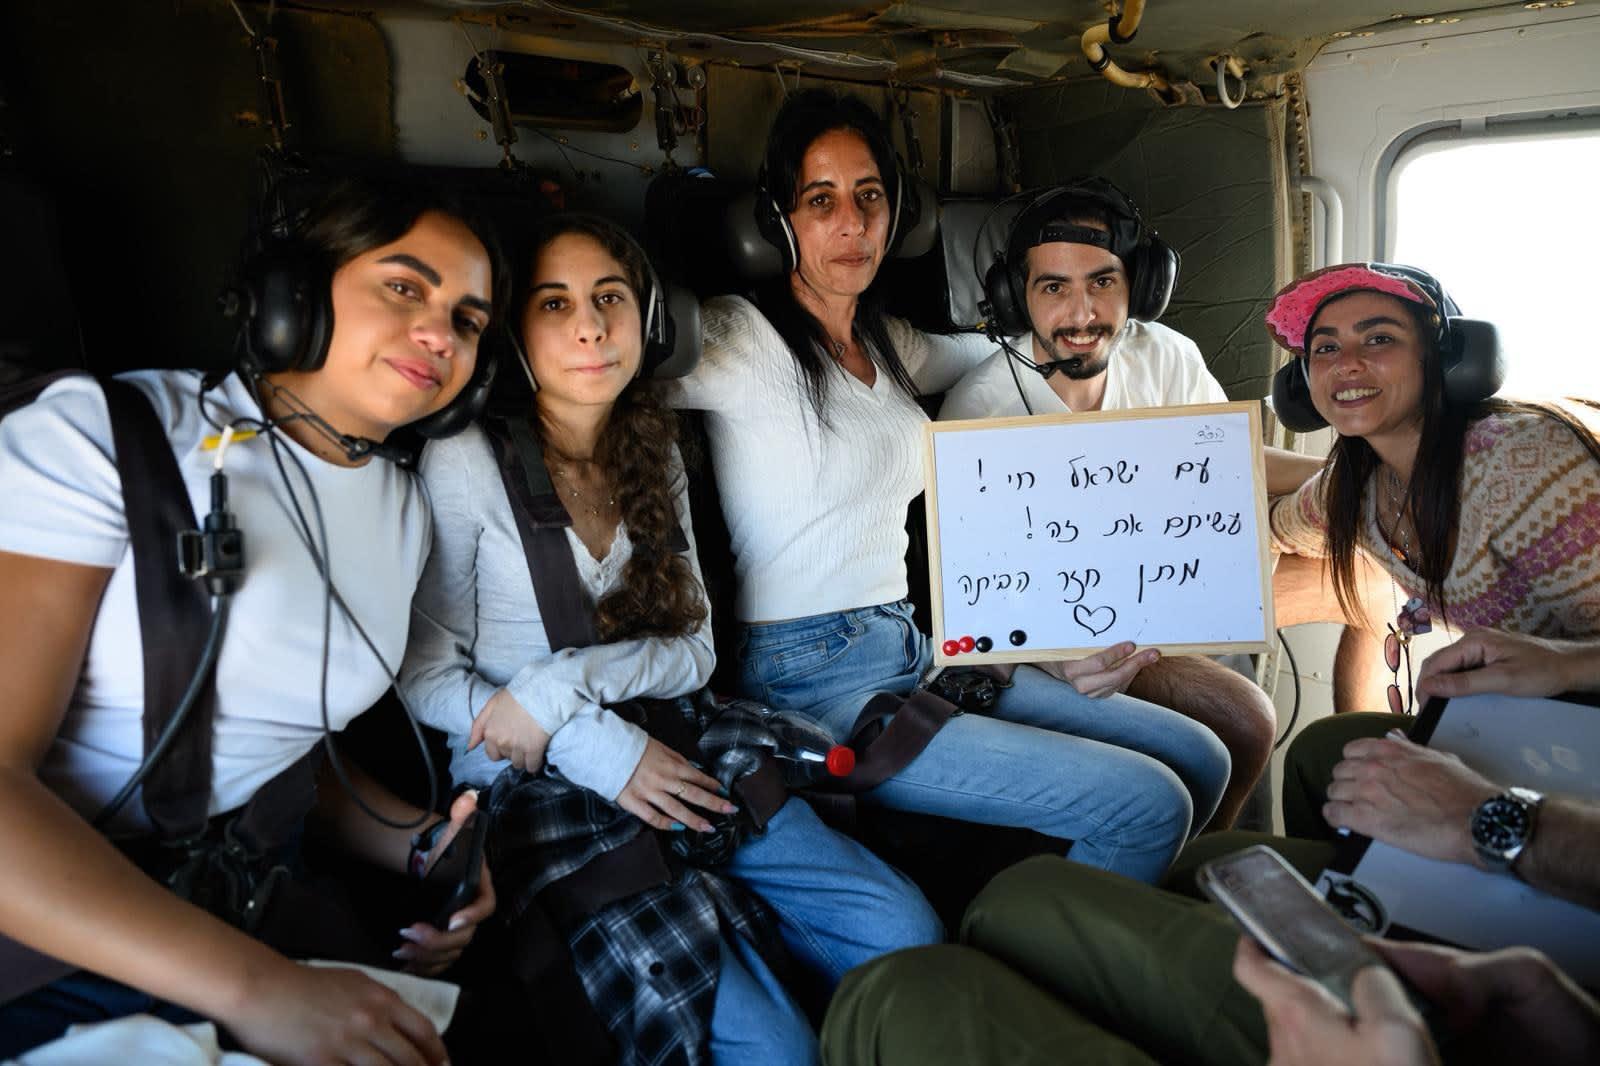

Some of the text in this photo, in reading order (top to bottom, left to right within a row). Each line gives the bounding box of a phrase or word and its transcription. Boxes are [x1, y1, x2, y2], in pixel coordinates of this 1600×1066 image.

[1007, 471, 1036, 490] חי
[1068, 454, 1139, 490] ישראל
[1174, 456, 1210, 485] עם
[1045, 519, 1080, 543] זה
[1102, 513, 1144, 537] את
[1162, 511, 1242, 539] עשיתם
[956, 557, 1201, 607] מתן חזר הביתה
